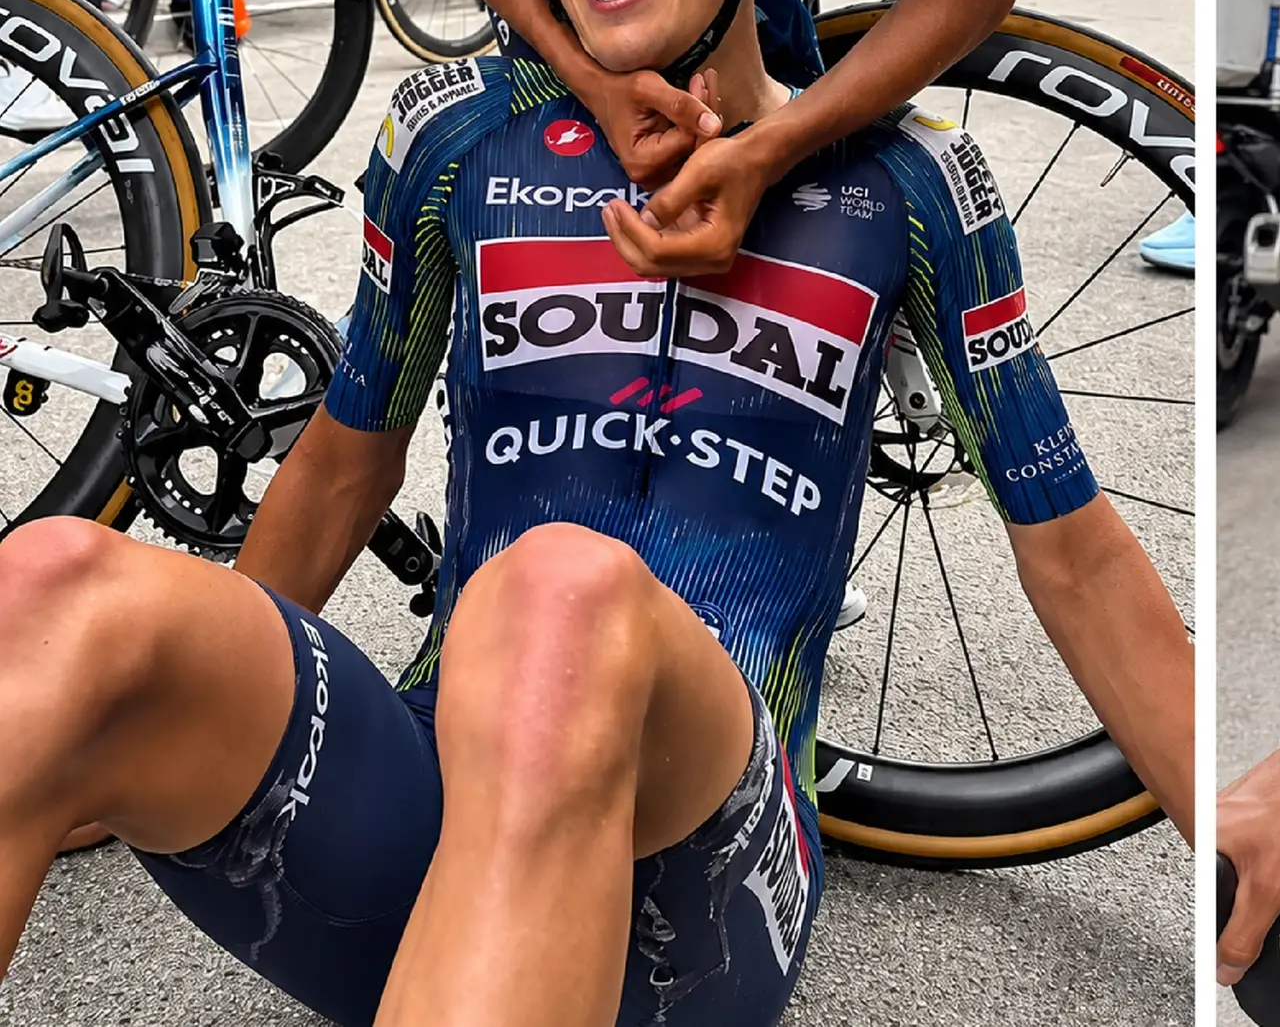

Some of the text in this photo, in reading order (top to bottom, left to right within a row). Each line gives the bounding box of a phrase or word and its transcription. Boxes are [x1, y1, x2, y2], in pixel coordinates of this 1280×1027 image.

[485, 176, 652, 213] Ekopak
[841, 185, 869, 198] UCI
[840, 196, 886, 213] WORLD
[840, 206, 874, 221] TEAM
[482, 291, 848, 409] SOUDAL
